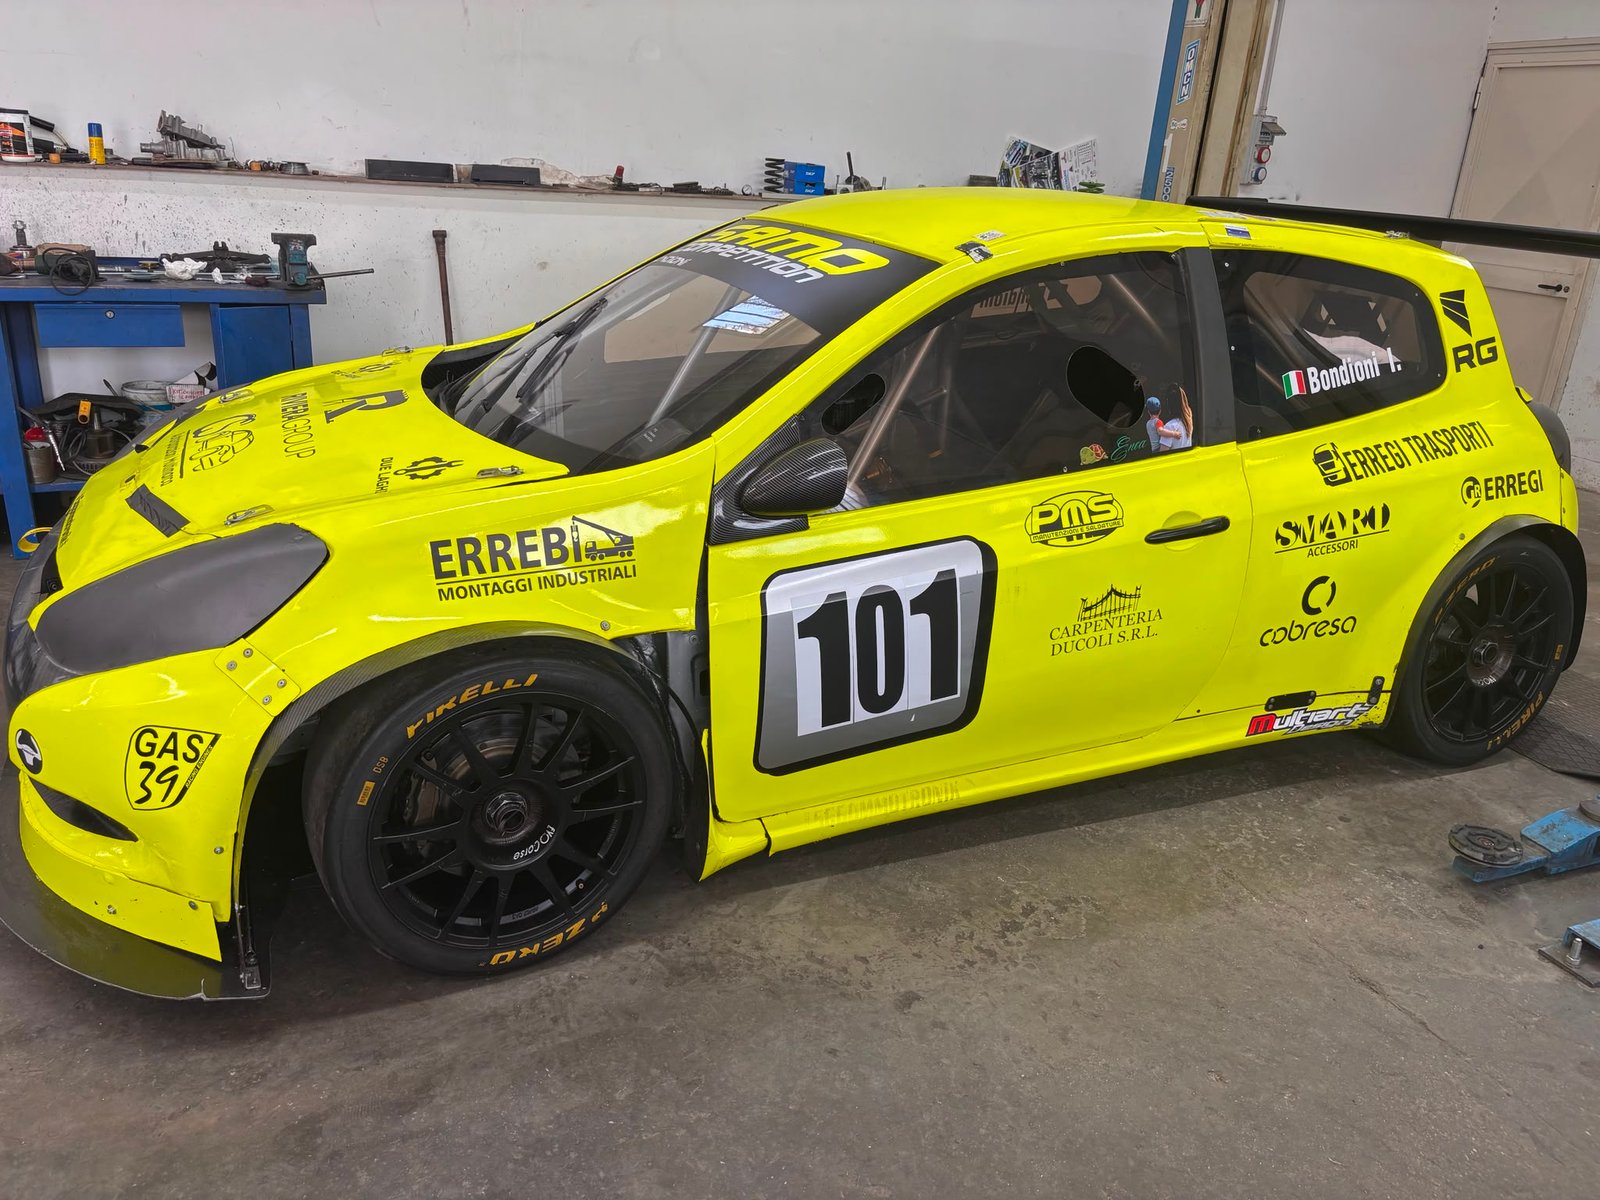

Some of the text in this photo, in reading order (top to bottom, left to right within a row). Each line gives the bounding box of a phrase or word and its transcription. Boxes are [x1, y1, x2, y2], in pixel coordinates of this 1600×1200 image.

[1181, 47, 1195, 98] OMCN
[1306, 351, 1381, 394] Bondioni
[1452, 336, 1499, 374] RG
[379, 457, 394, 471] DUE
[1345, 420, 1494, 481] ERREGI TRASPORTI
[1484, 469, 1544, 501] ERREGI
[1031, 493, 1119, 535] PMS
[429, 525, 583, 580] ERREBI
[1307, 539, 1359, 558] ACCESSORI
[437, 564, 638, 602] MONTAGGI INDUSTRIALI
[1049, 608, 1163, 641] CARPENTERIA
[1050, 626, 1158, 657] DUCOLI S.R.L.
[1259, 616, 1357, 647] cobresa
[797, 568, 959, 729] 101
[406, 673, 539, 739] PIRELLI
[134, 728, 204, 764] GAS
[134, 760, 180, 805] 39
